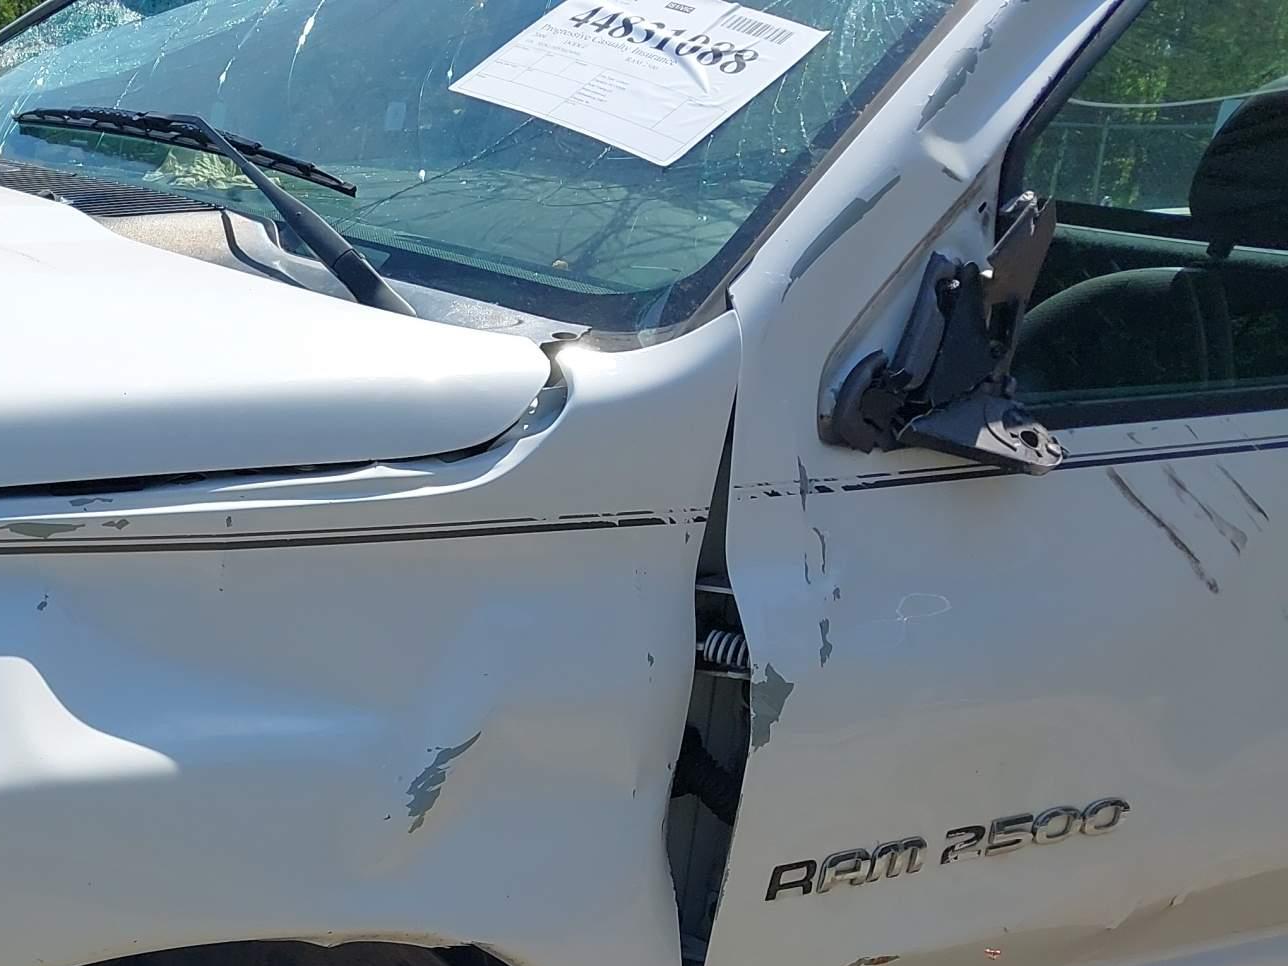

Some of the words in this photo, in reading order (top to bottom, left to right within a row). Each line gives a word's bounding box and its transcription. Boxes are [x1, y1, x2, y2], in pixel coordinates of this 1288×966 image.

[592, 36, 629, 53] Casualty
[764, 835, 928, 902] RAM
[940, 796, 1131, 865] 2500
